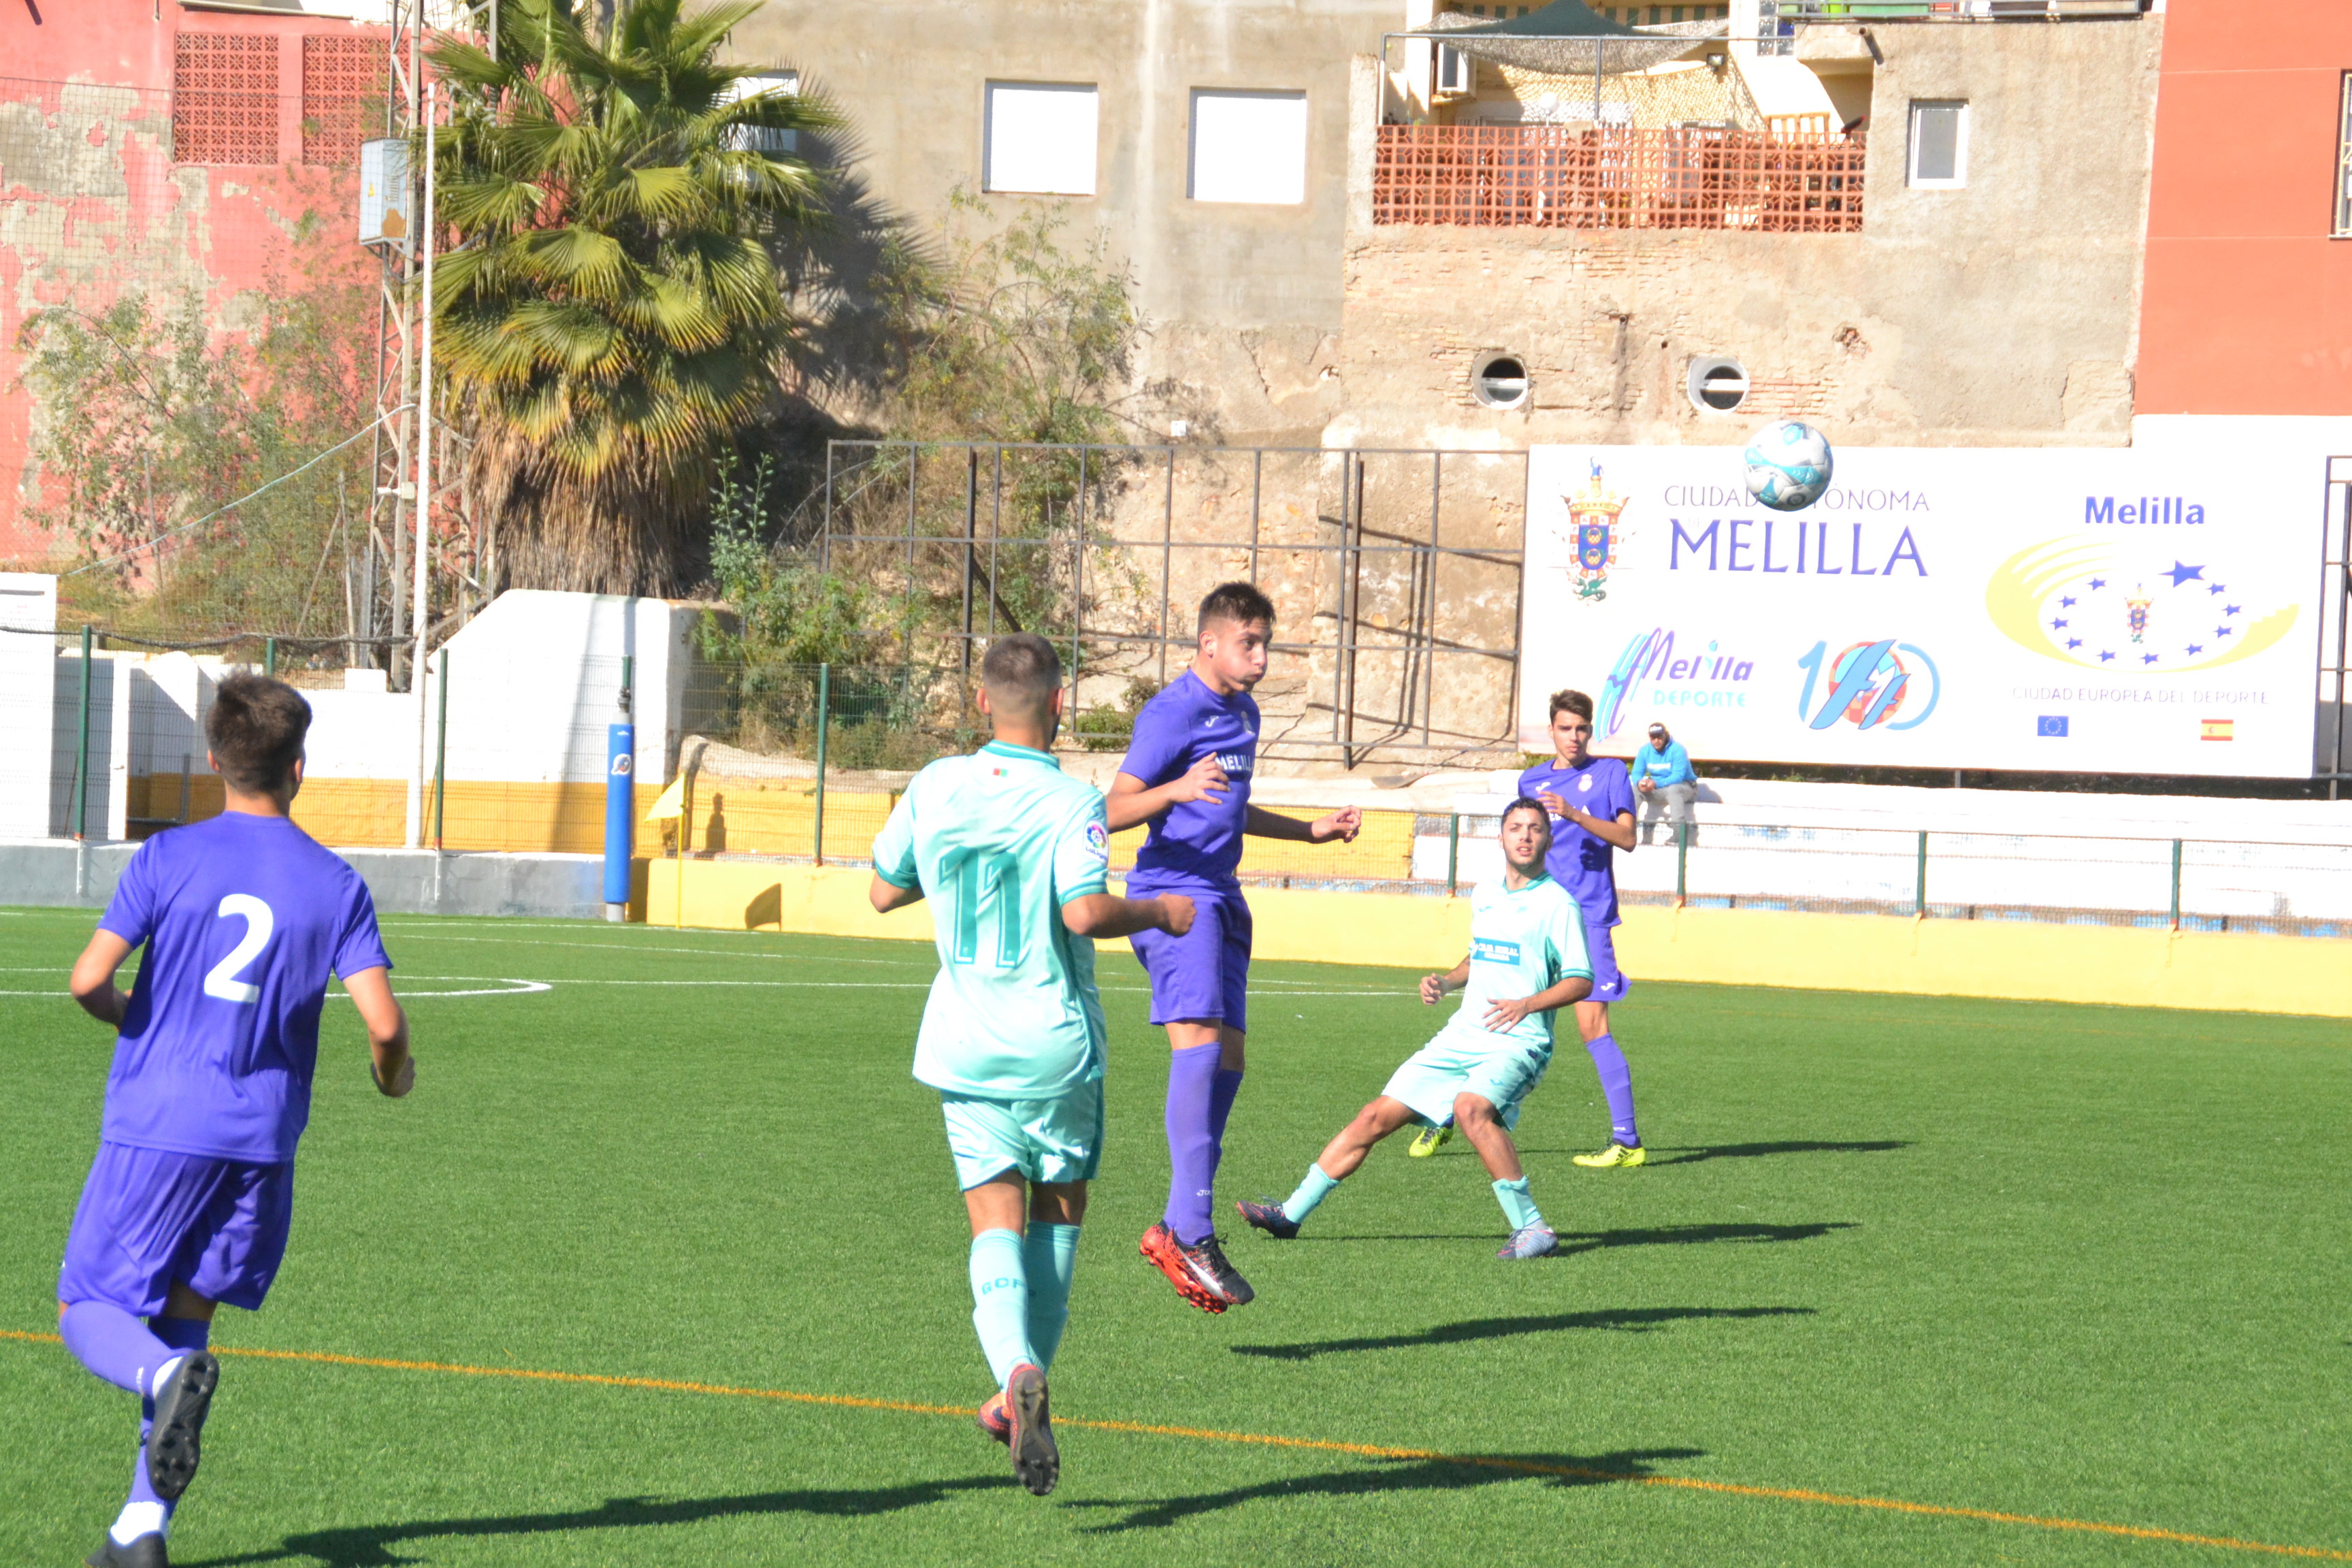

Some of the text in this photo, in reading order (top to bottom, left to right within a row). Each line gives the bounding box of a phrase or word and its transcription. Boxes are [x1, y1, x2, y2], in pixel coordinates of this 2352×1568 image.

[2085, 496, 2205, 525] Melilla
[1669, 518, 1929, 577] MELILLA
[1653, 689, 1746, 708] DEPORTE
[2012, 687, 2270, 704] CIUDAD EUROPEA DEL DEPORTE
[938, 845, 1021, 968] 11
[204, 894, 274, 1003] 2
